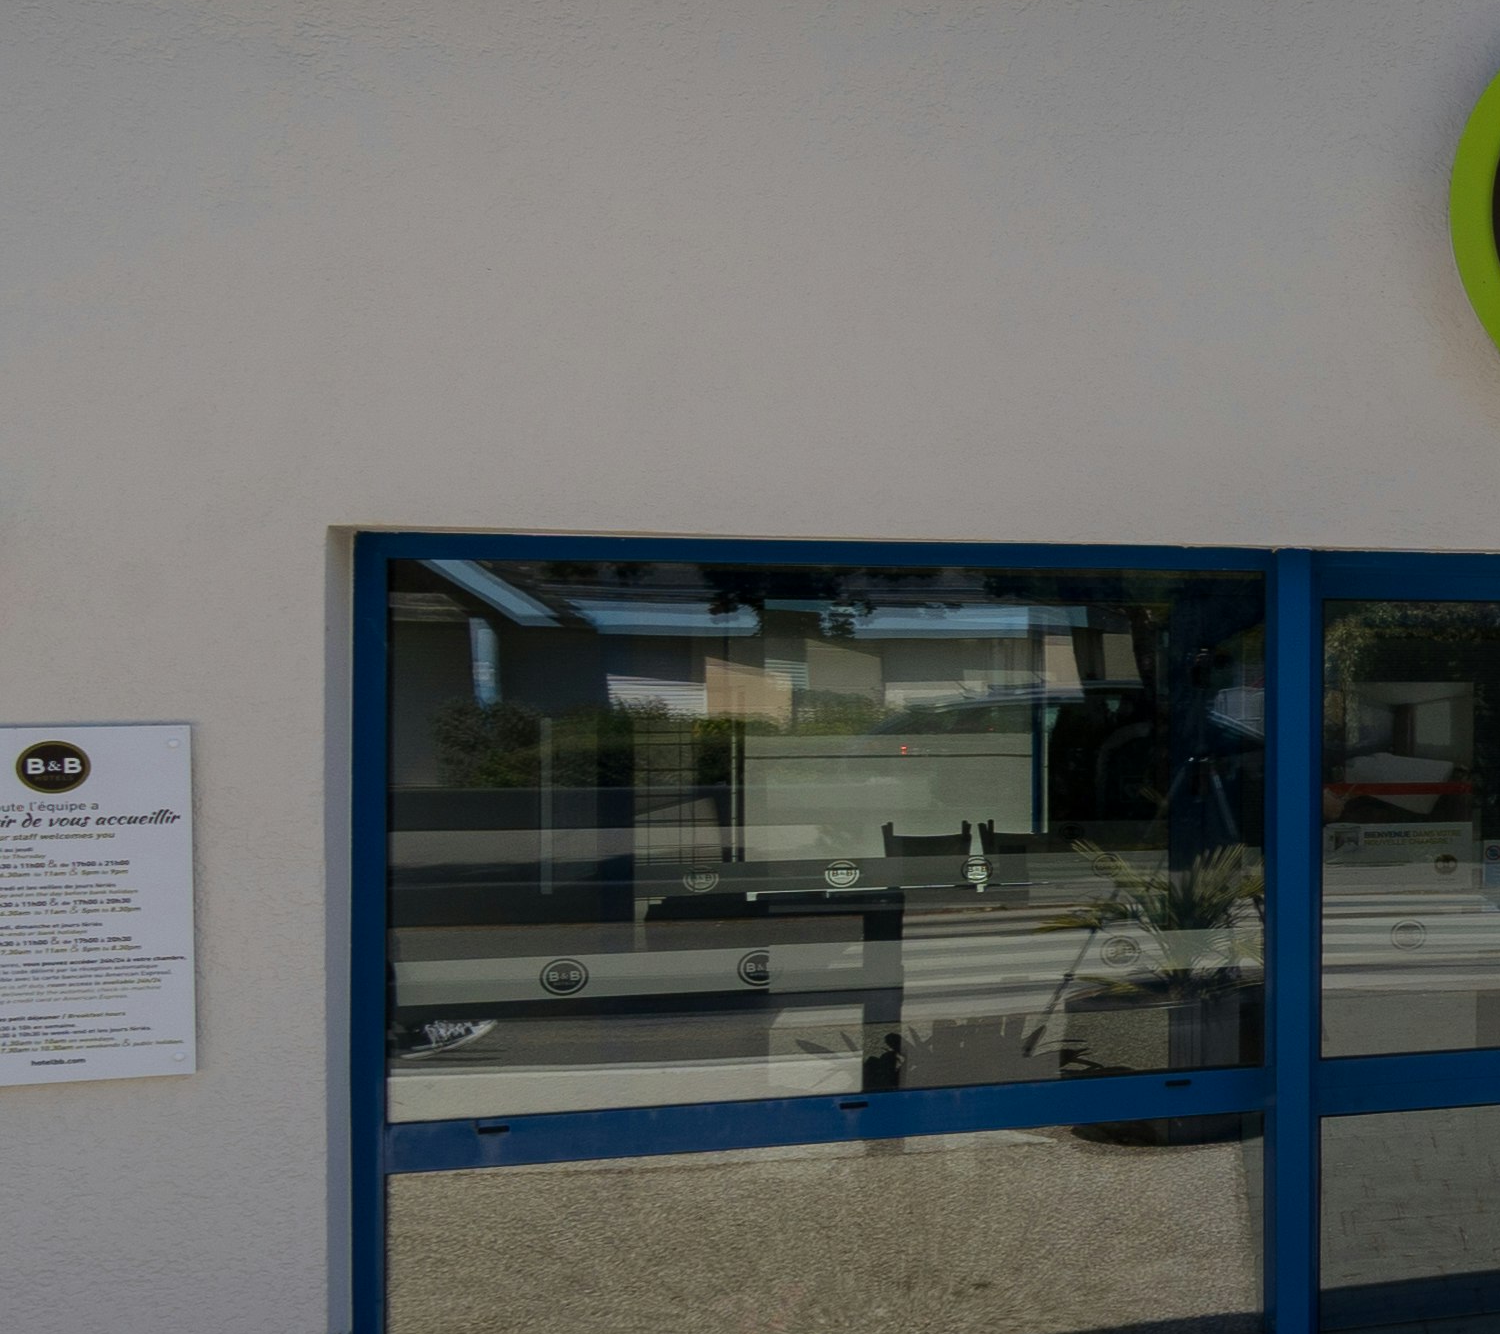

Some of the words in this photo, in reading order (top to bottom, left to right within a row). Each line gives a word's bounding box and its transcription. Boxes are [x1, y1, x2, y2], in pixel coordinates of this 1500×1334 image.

[22, 813, 42, 828] de
[49, 816, 91, 828] vous
[96, 809, 181, 826] accueillir
[40, 833, 94, 841] welcomes
[96, 832, 116, 841] you
